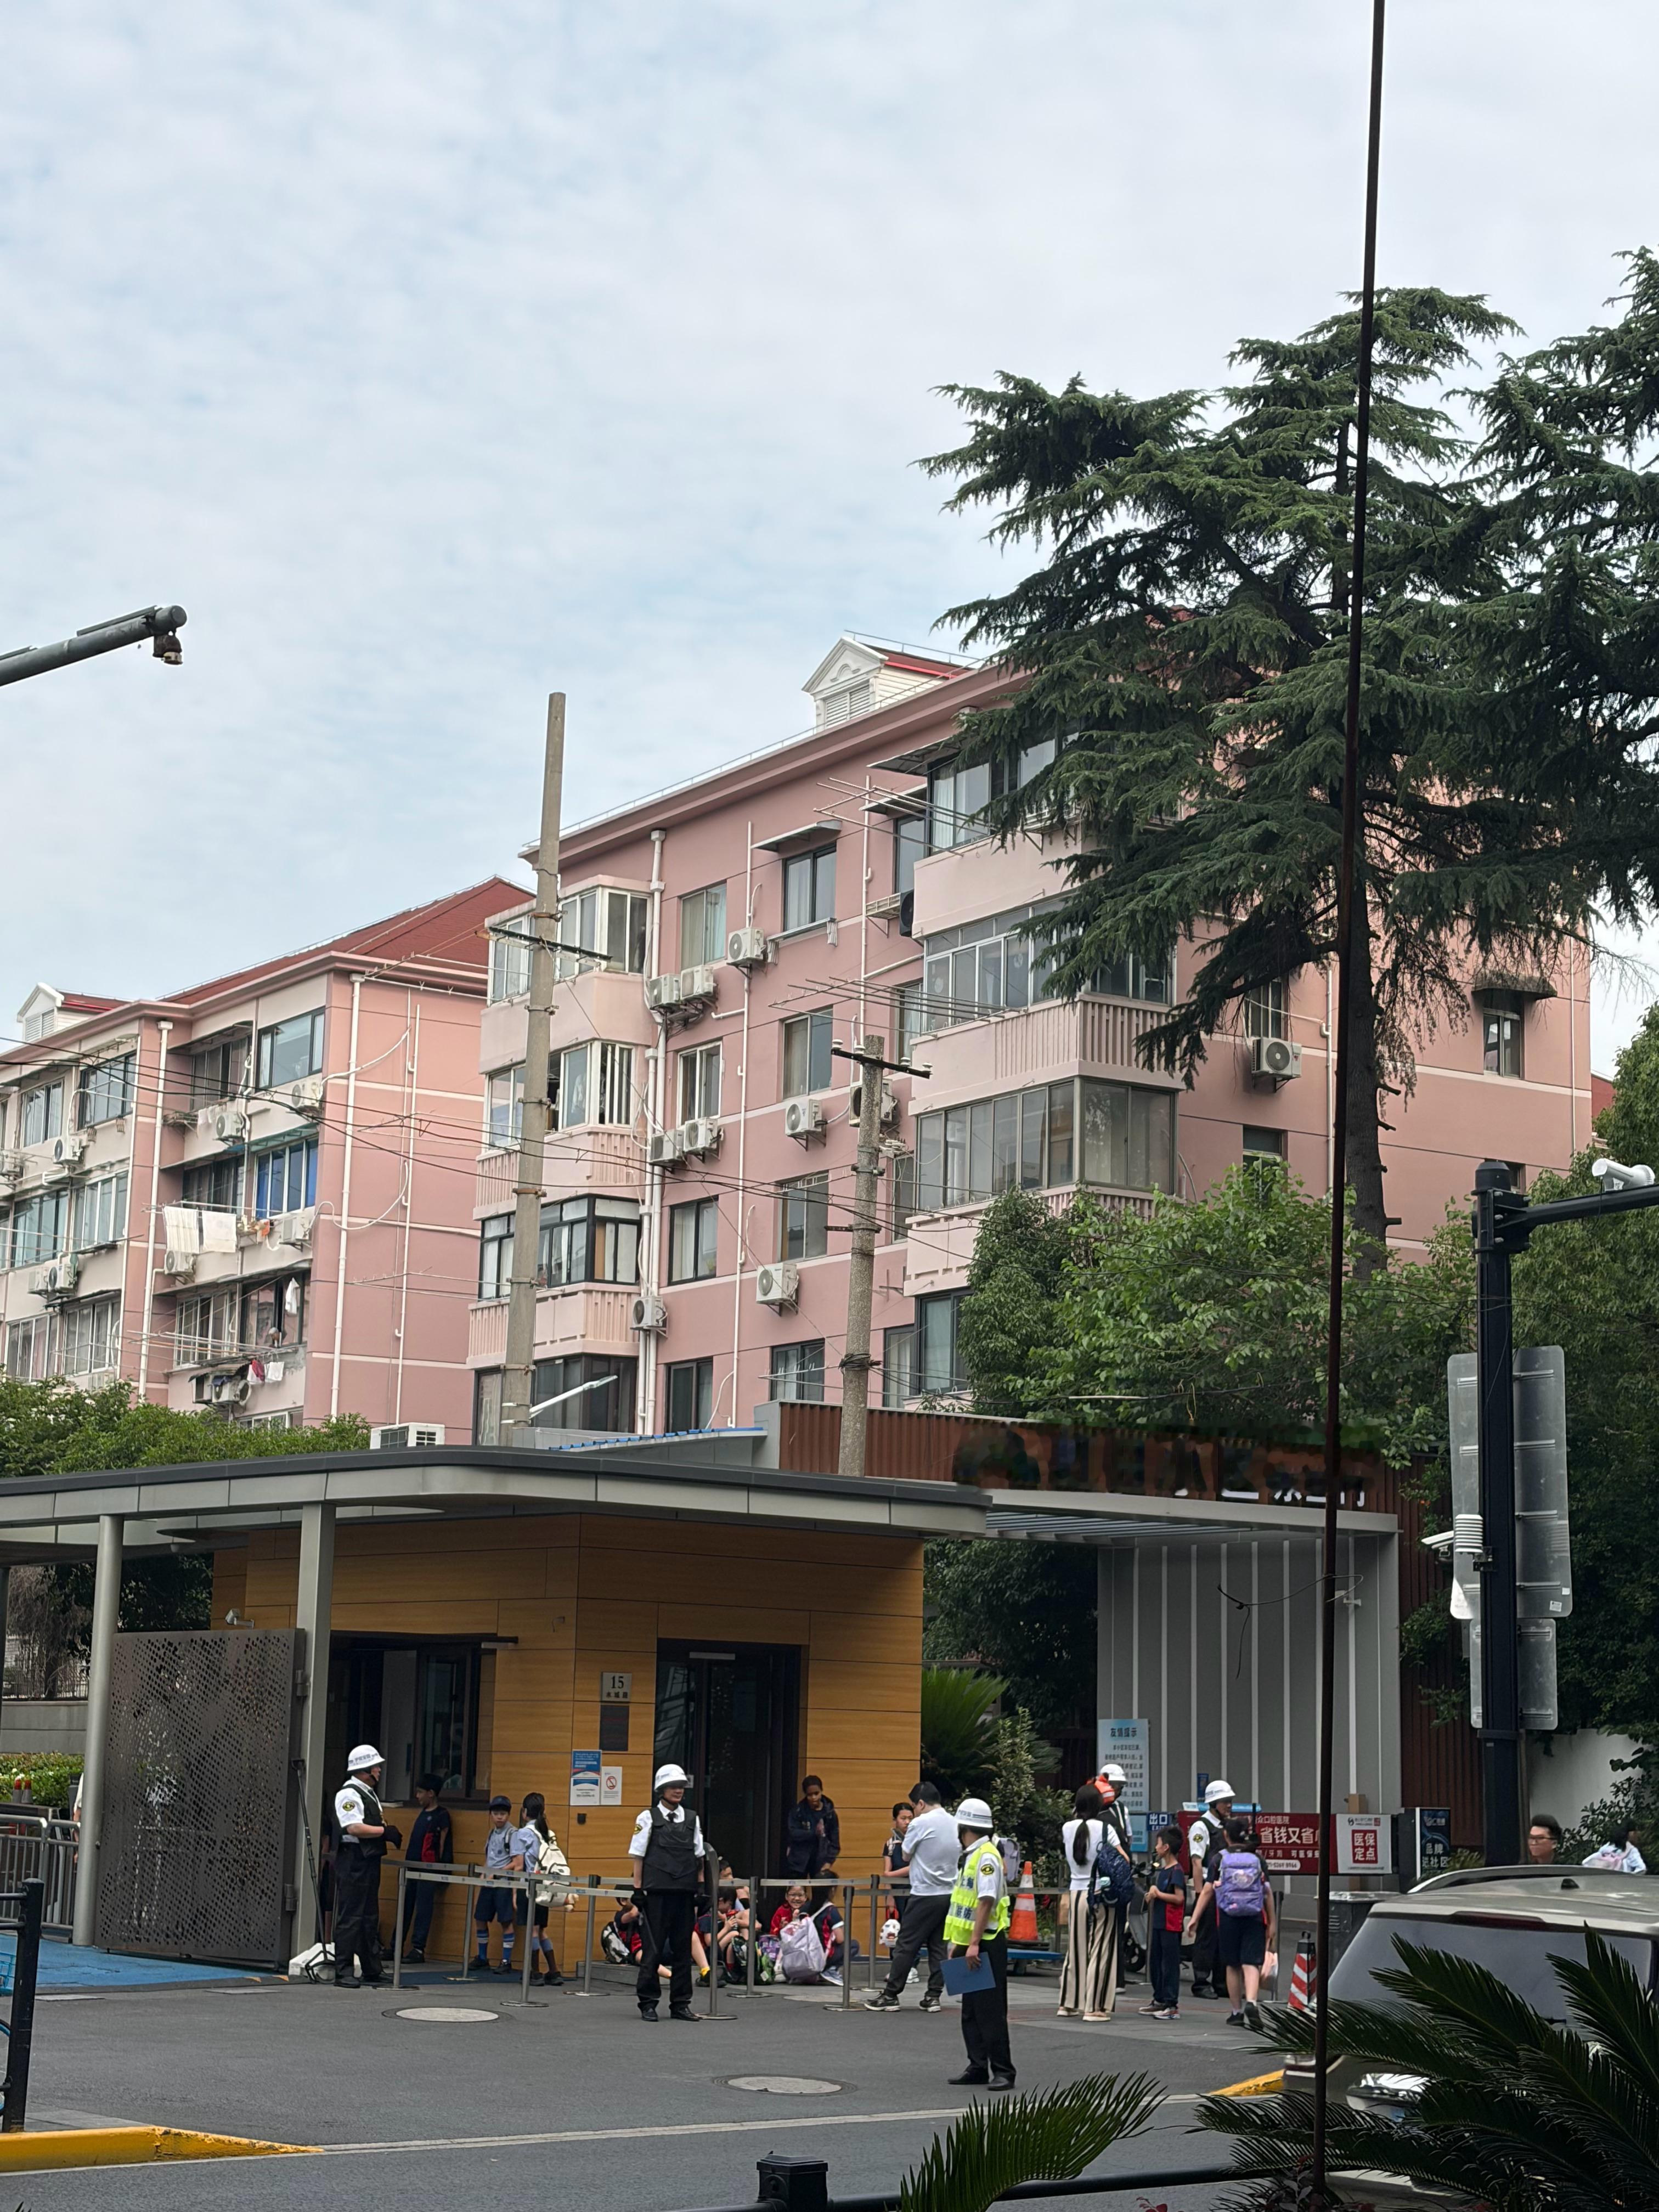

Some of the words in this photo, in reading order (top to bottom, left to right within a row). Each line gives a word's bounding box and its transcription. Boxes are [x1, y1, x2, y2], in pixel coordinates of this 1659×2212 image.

[611, 1675, 624, 1689] 15
[1110, 1727, 1137, 1737] 友情提示
[1149, 1813, 1168, 1825] 出口
[1354, 1833, 1375, 1846] 医保
[1355, 1847, 1376, 1861] 定点
[1426, 1843, 1444, 1854] 品牌
